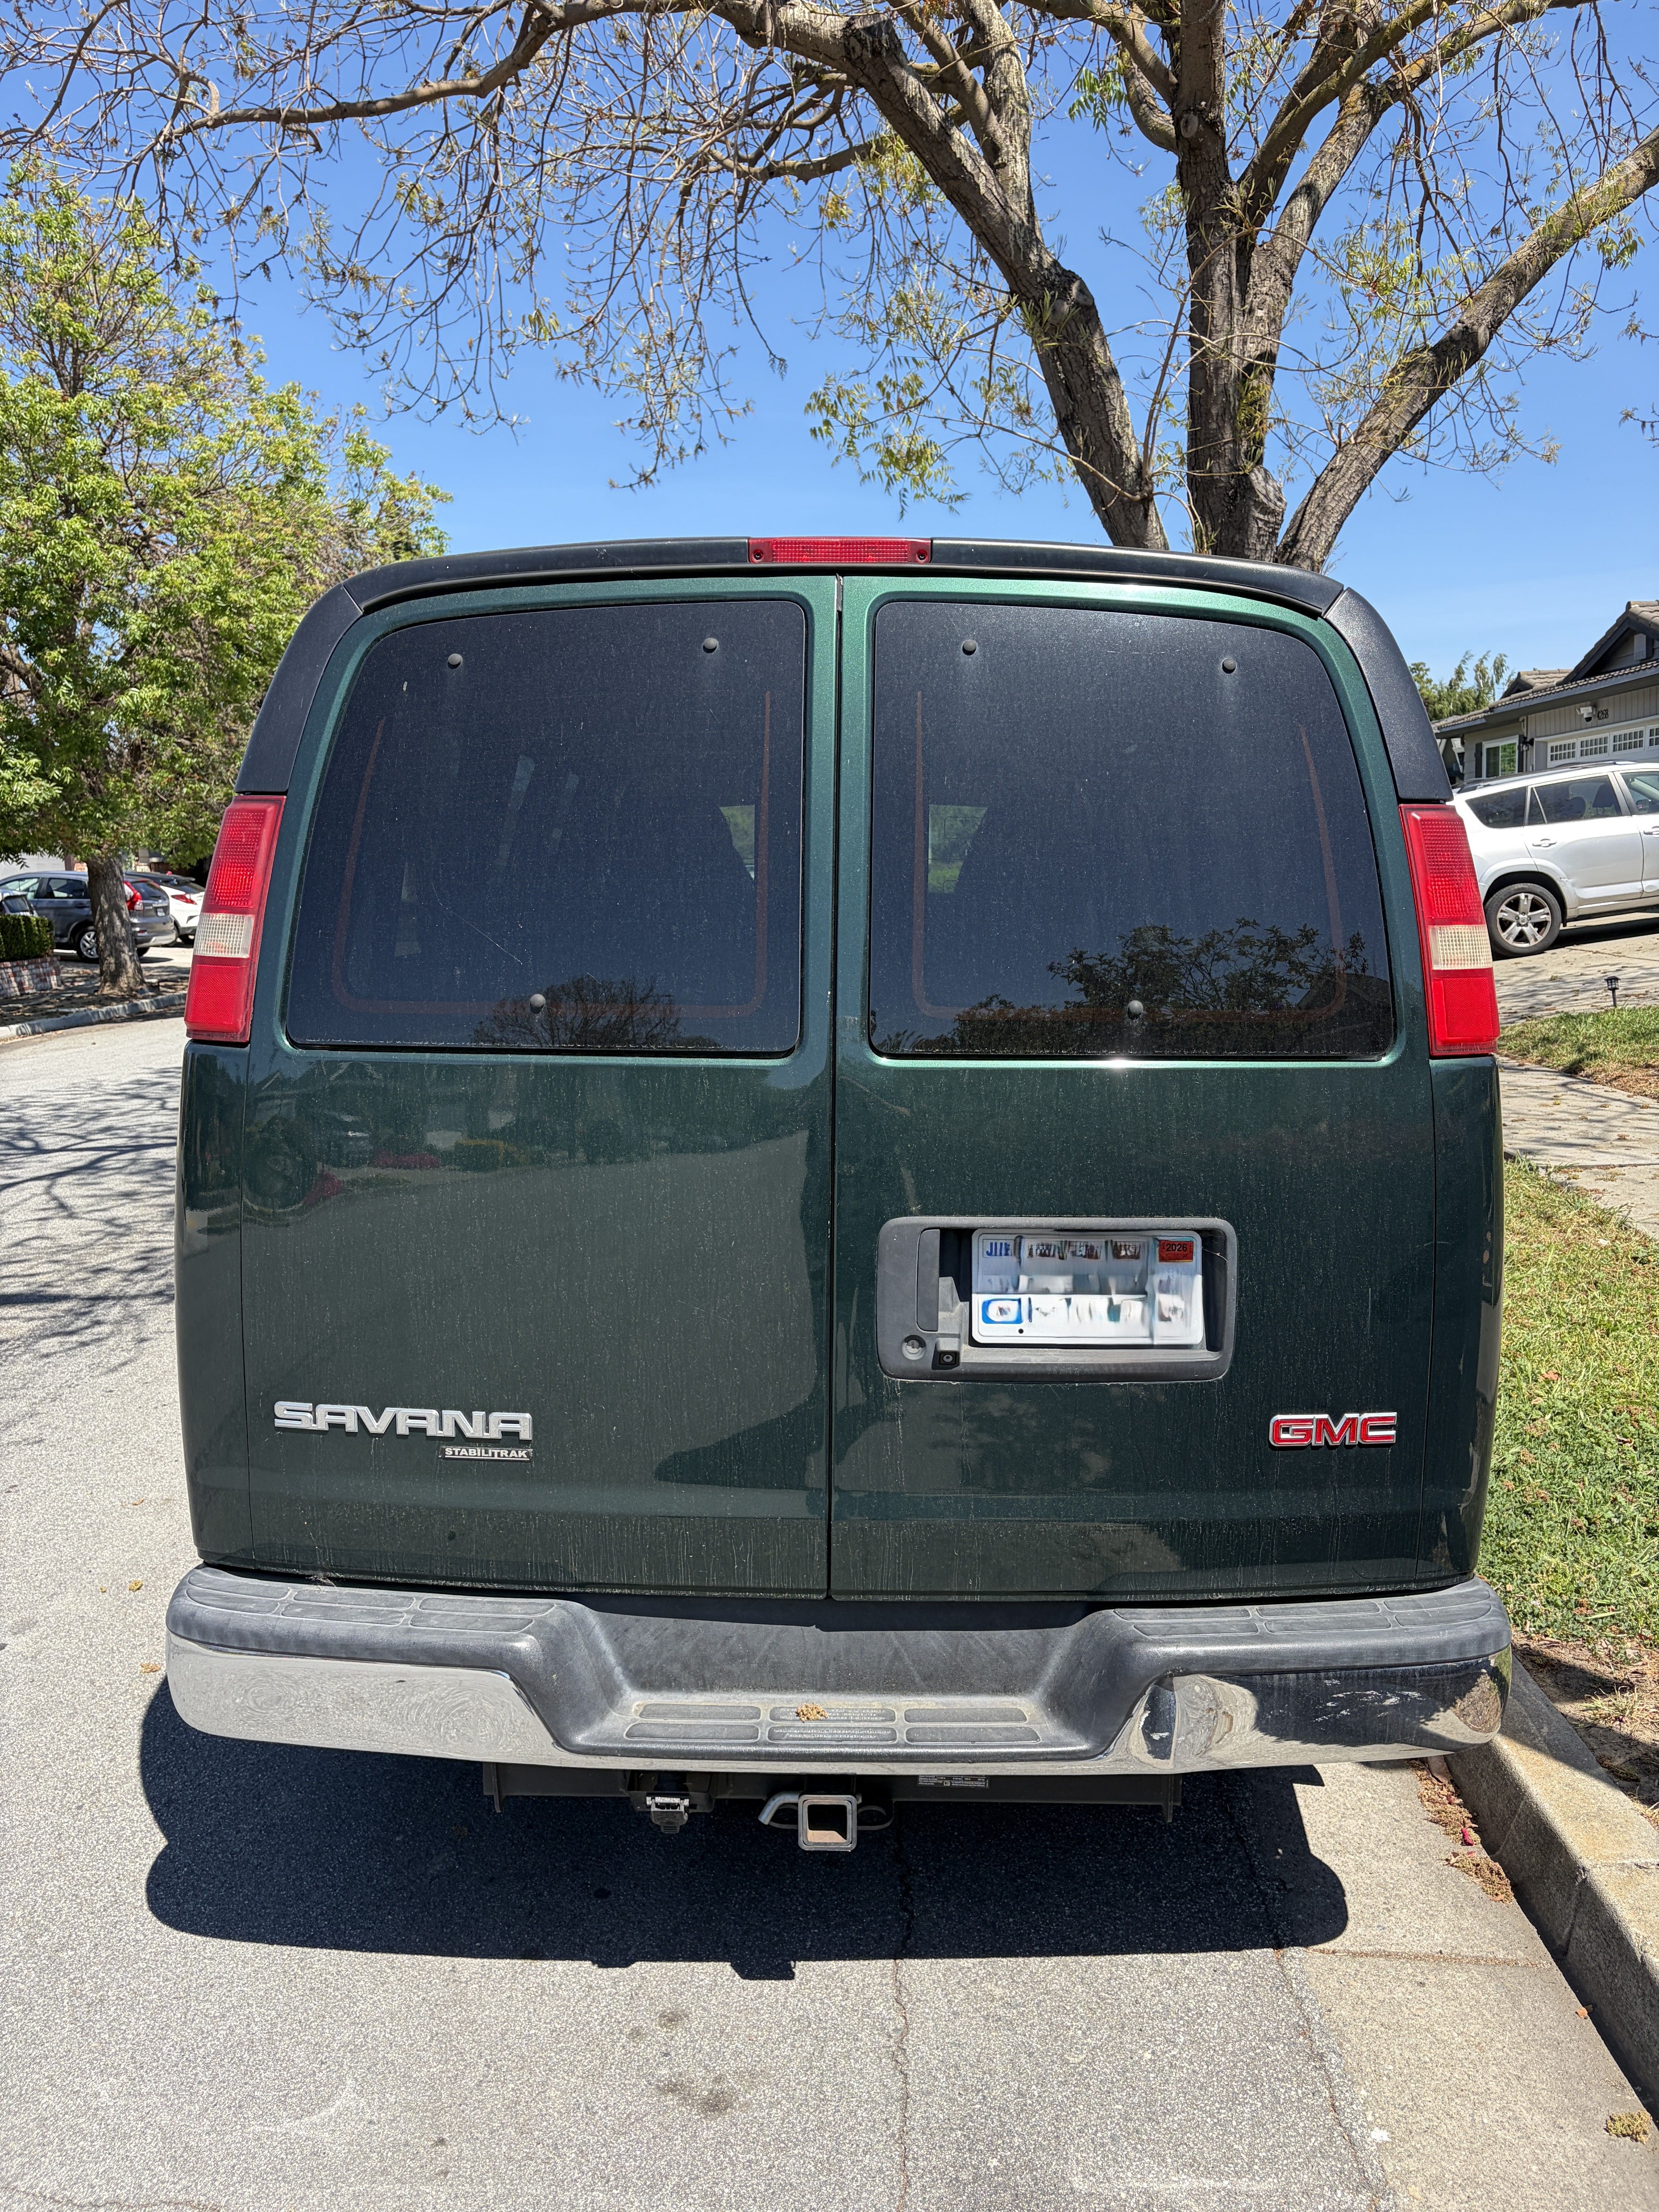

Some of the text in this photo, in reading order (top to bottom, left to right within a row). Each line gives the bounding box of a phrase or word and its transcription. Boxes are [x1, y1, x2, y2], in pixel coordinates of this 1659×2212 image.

[1597, 708, 1609, 720] 4268
[1166, 1243, 1188, 1252] 2026
[274, 1401, 532, 1441] SAVANA
[1269, 1412, 1397, 1446] GMC
[445, 1448, 528, 1460] STABILITRAK
